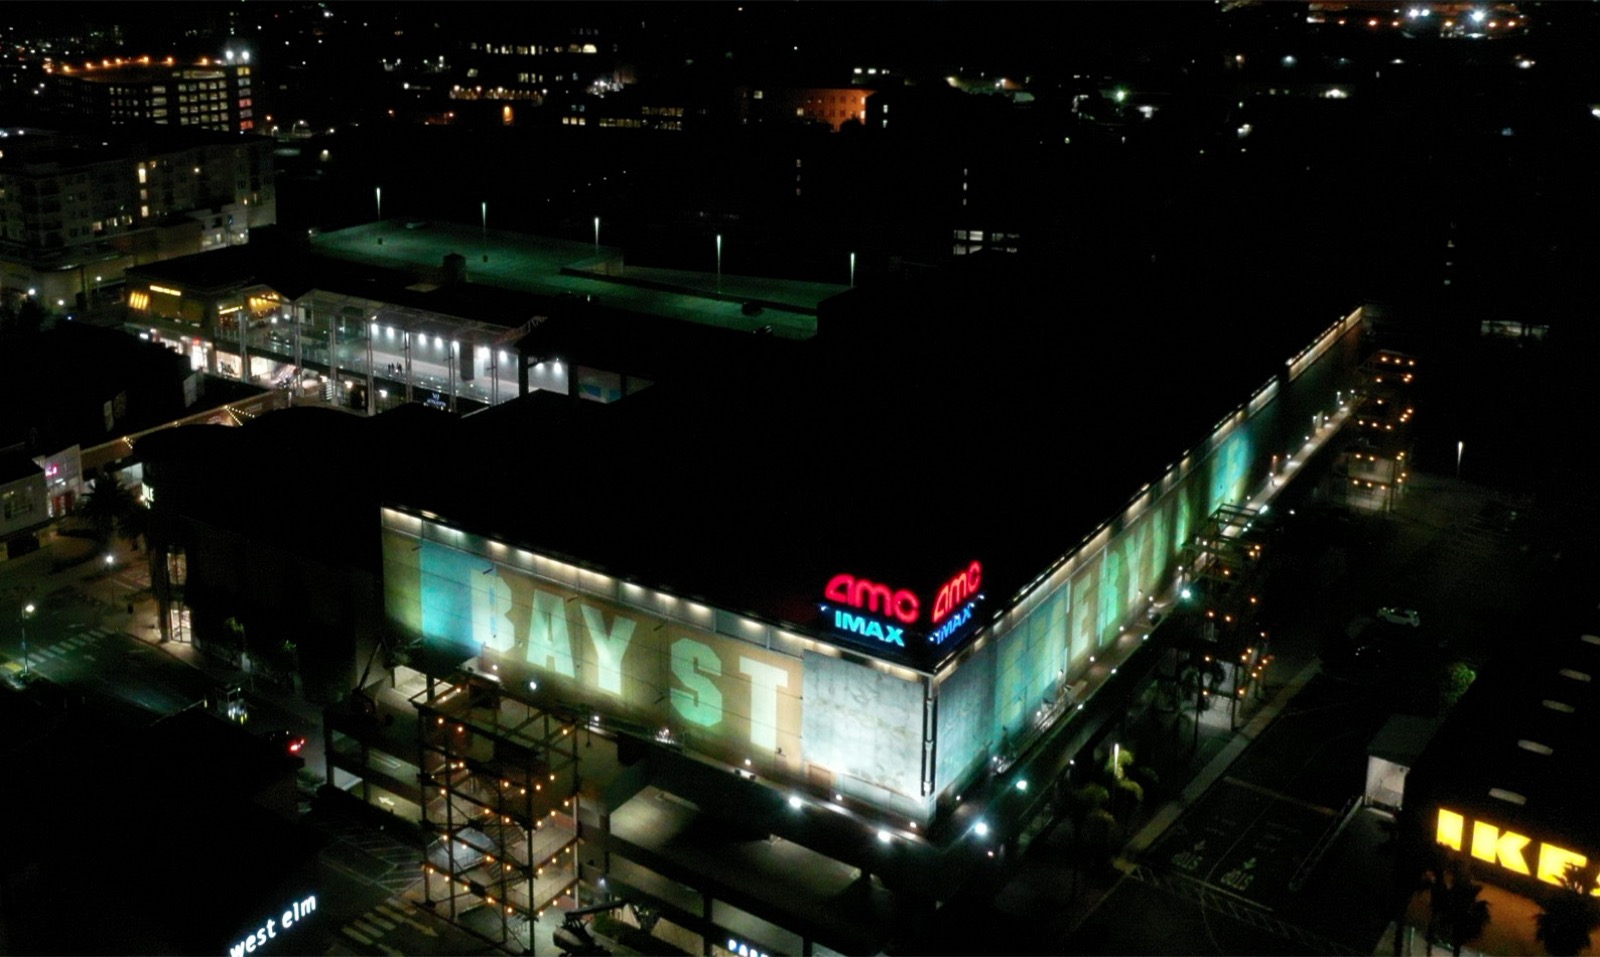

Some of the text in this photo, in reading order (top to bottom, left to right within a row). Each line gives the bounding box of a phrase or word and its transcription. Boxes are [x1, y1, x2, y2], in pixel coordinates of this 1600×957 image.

[1000, 437, 1247, 727] EMERYVILE
[835, 610, 905, 647] IMAX
[936, 606, 973, 645] IMAX
[470, 568, 788, 751] BAY ST
[1437, 808, 1600, 897] IKE
[230, 896, 316, 957] west elm
[728, 939, 768, 957] PAR
